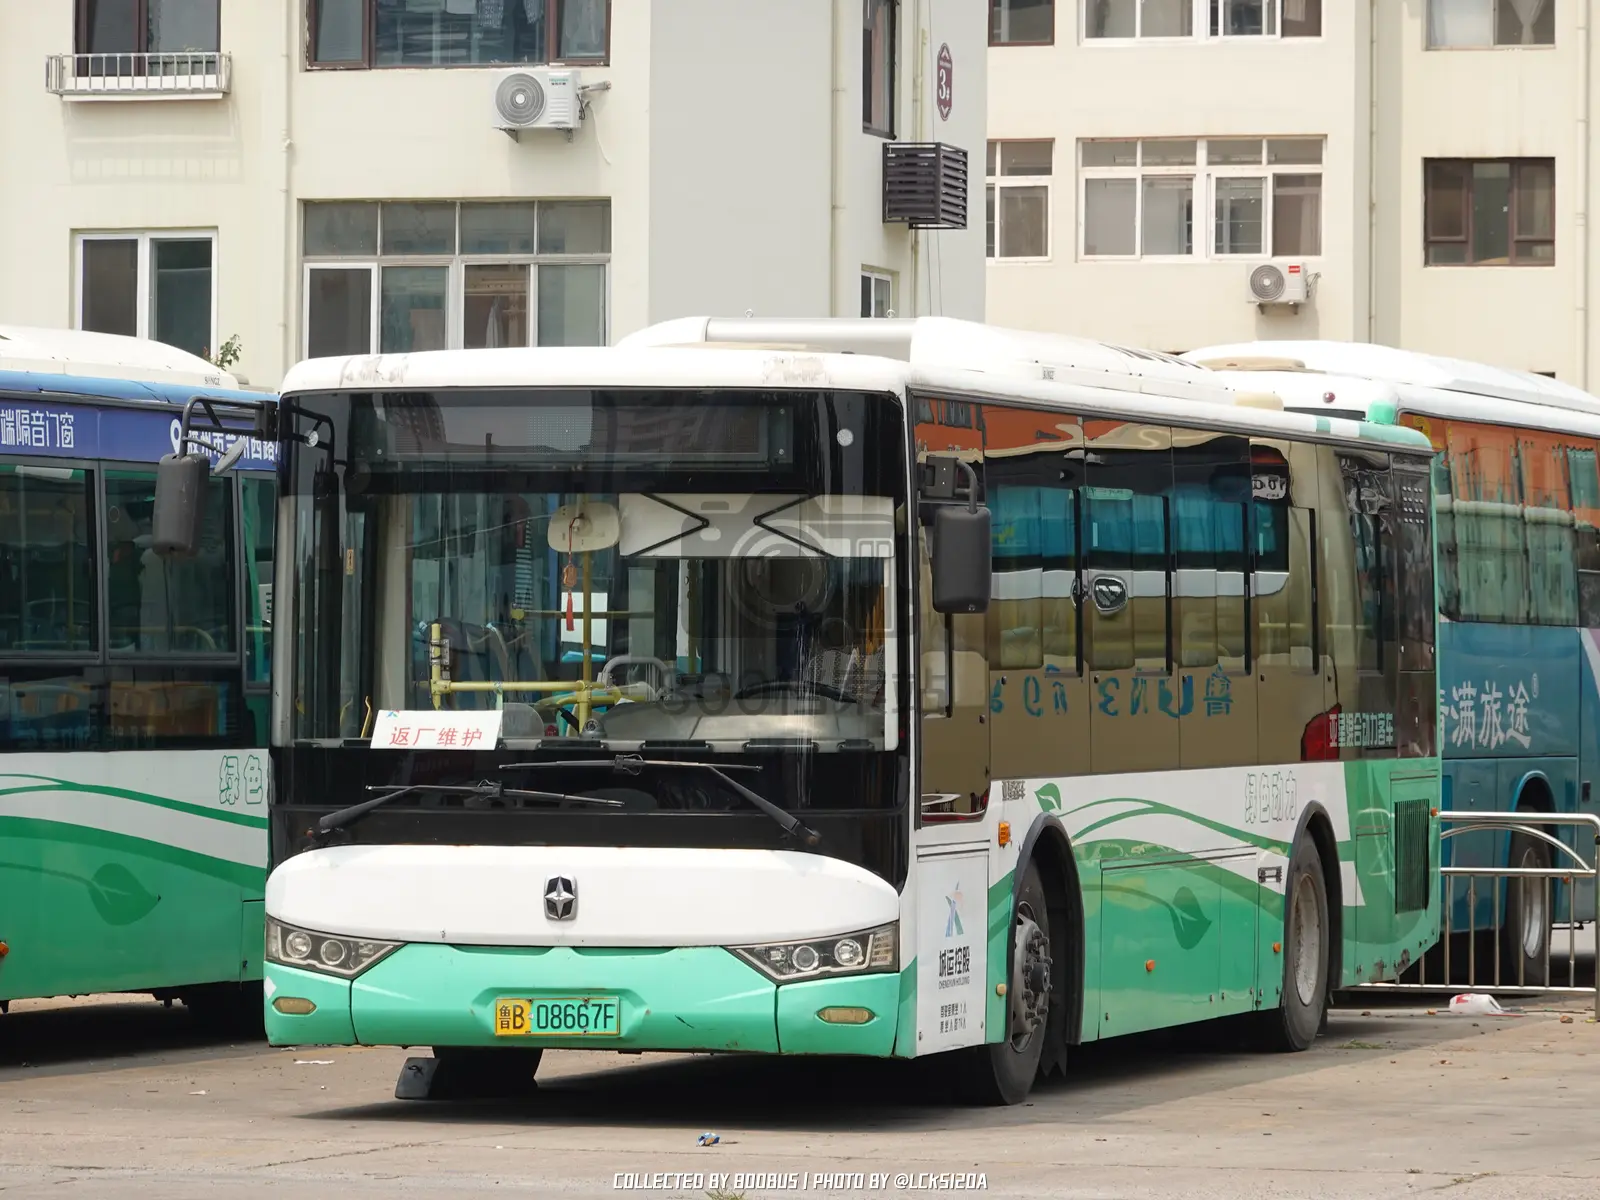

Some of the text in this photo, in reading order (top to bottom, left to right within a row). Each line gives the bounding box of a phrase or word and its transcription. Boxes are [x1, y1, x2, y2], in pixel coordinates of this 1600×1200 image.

[388, 726, 483, 747] 返厂维护
[1244, 770, 1297, 824] 绿色动力
[938, 945, 971, 978] 城运控股
[499, 1003, 616, 1030] 鲁B 08667F
